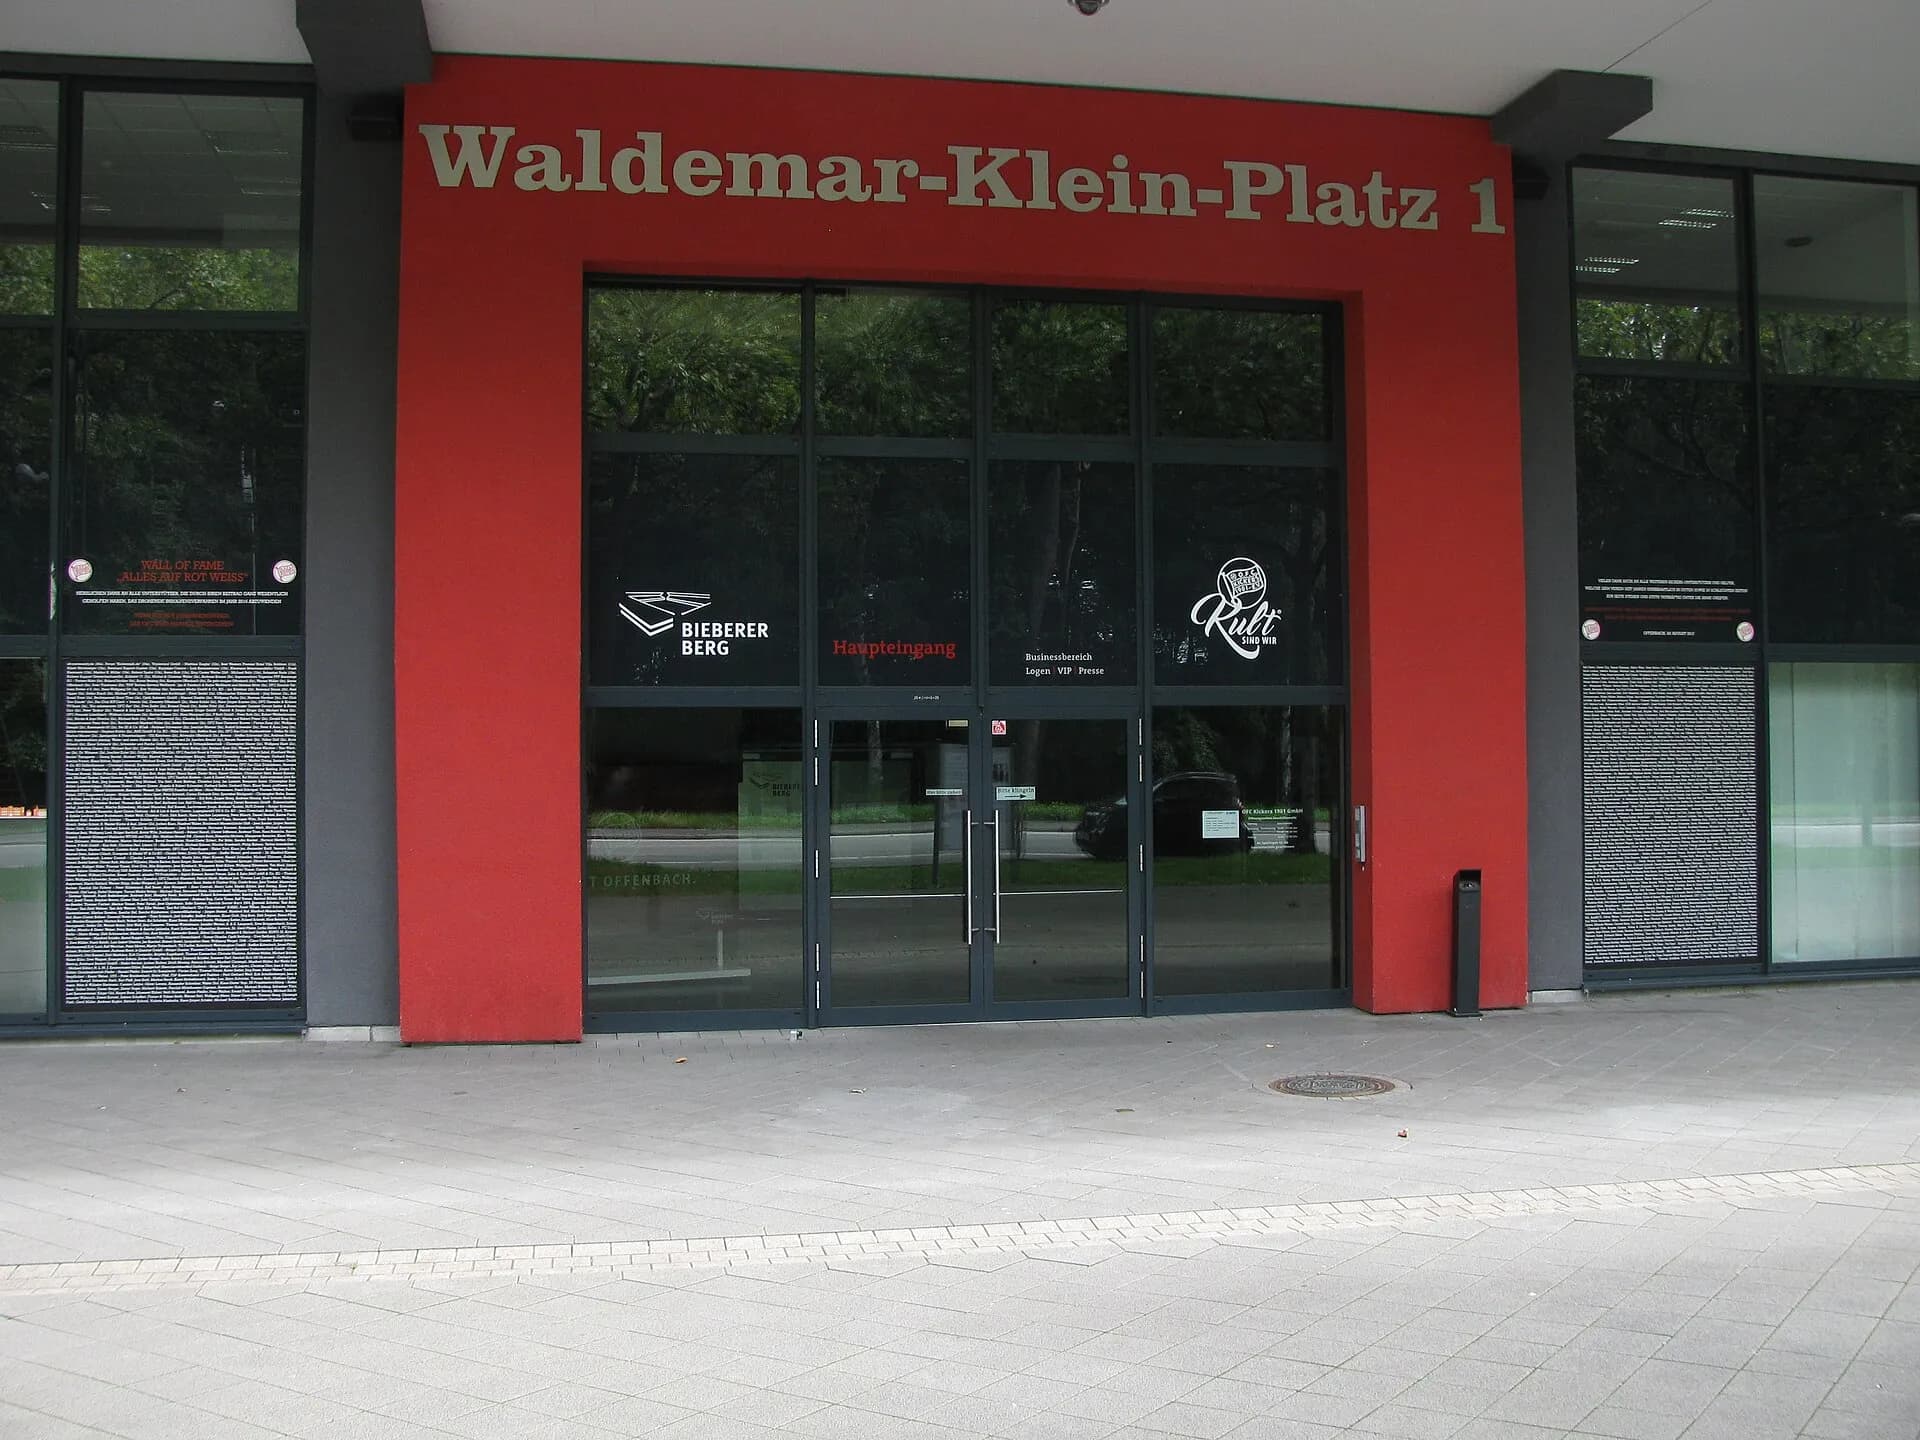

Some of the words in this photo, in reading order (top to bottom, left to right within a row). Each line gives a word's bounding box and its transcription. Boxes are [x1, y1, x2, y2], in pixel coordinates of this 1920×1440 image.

[419, 124, 1438, 231] Waldemar-Klein-Platz
[1469, 177, 1506, 234] 1
[141, 560, 172, 570] WALL
[175, 561, 191, 570] OF
[193, 561, 224, 570] FAME
[184, 572, 207, 582] ROT
[681, 622, 769, 639] BIEBERER
[1241, 636, 1260, 645] SIND
[1261, 636, 1277, 645] WIR
[681, 640, 729, 656] BERG
[833, 639, 957, 660] Haupteingang
[1025, 652, 1093, 661] Businessbereich
[1025, 667, 1051, 677] Logen
[1057, 667, 1072, 675] VIP
[1078, 667, 1105, 675] Presse
